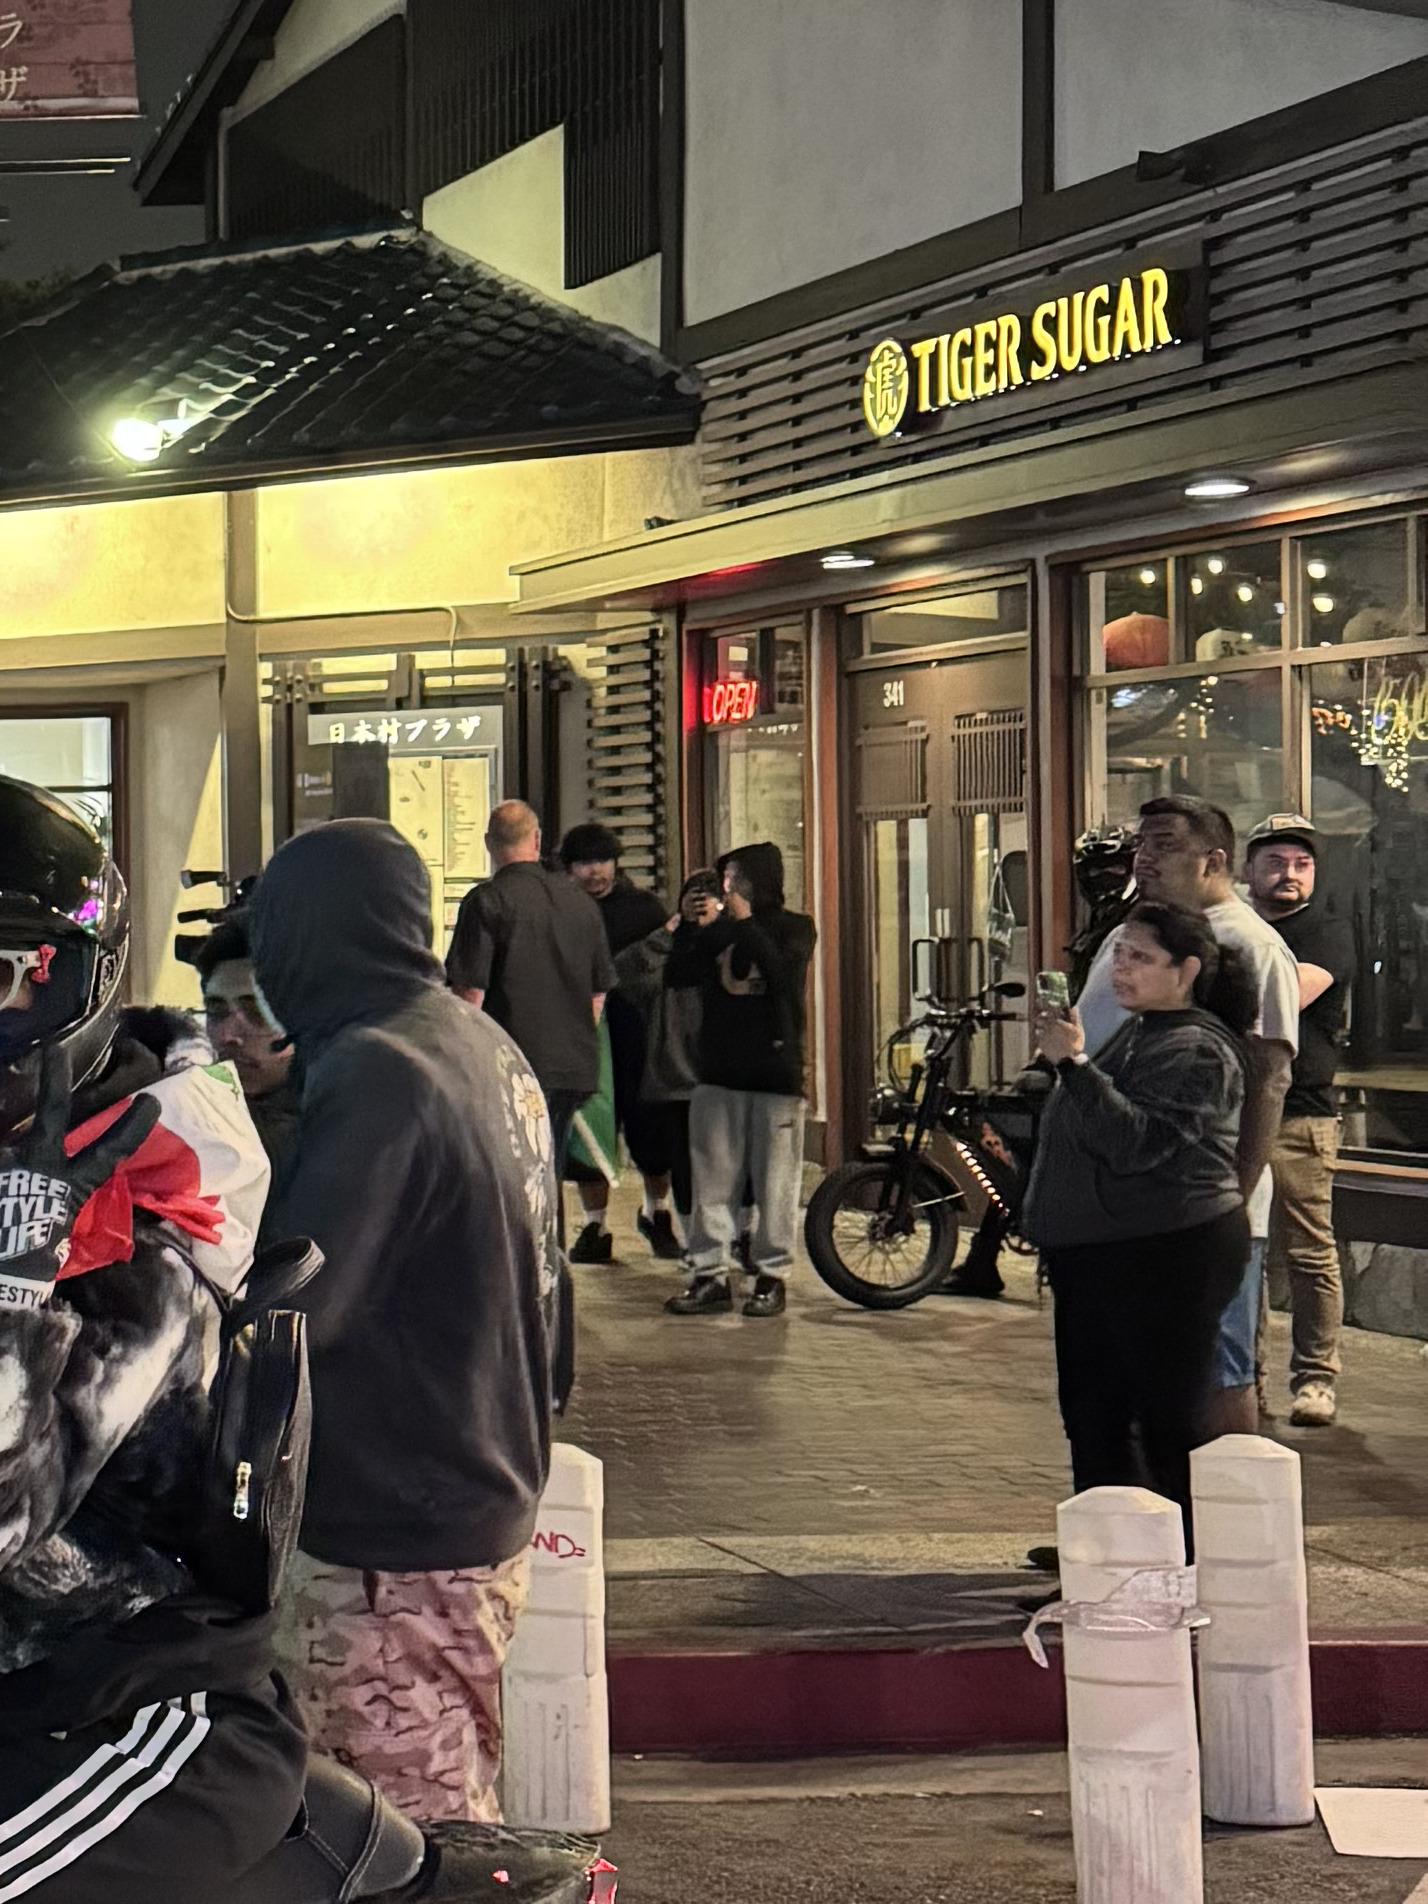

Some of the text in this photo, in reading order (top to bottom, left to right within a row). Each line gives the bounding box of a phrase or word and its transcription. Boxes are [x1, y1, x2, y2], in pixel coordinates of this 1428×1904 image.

[911, 267, 1173, 414] TIGER SUGAR
[712, 680, 757, 722] OPEN
[882, 680, 905, 708] 341
[329, 715, 482, 745] 日本村プラザ
